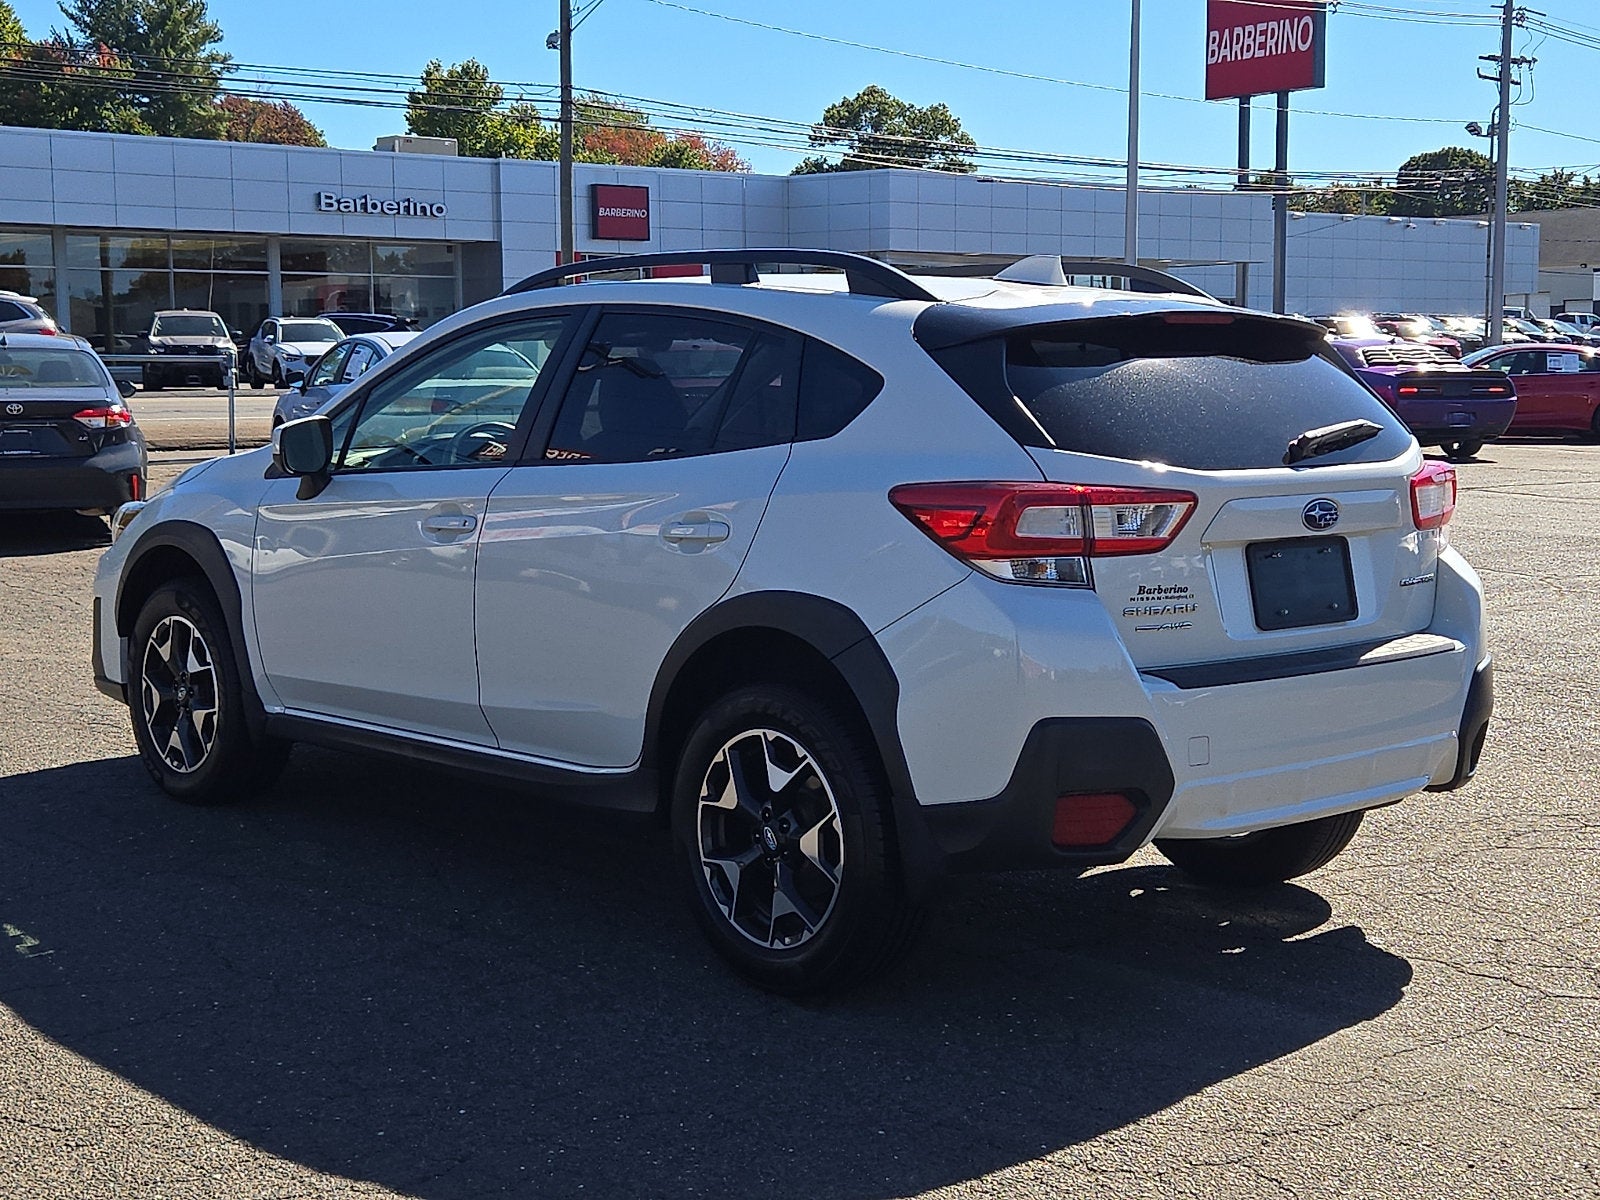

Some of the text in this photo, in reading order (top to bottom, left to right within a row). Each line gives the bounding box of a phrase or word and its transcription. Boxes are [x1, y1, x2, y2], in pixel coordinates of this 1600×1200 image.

[1207, 15, 1314, 65] BARBERINO
[318, 191, 448, 217] Barberino
[598, 207, 648, 218] BARBERINO
[1137, 584, 1189, 595] Barberino
[1122, 603, 1199, 617] SUBARU
